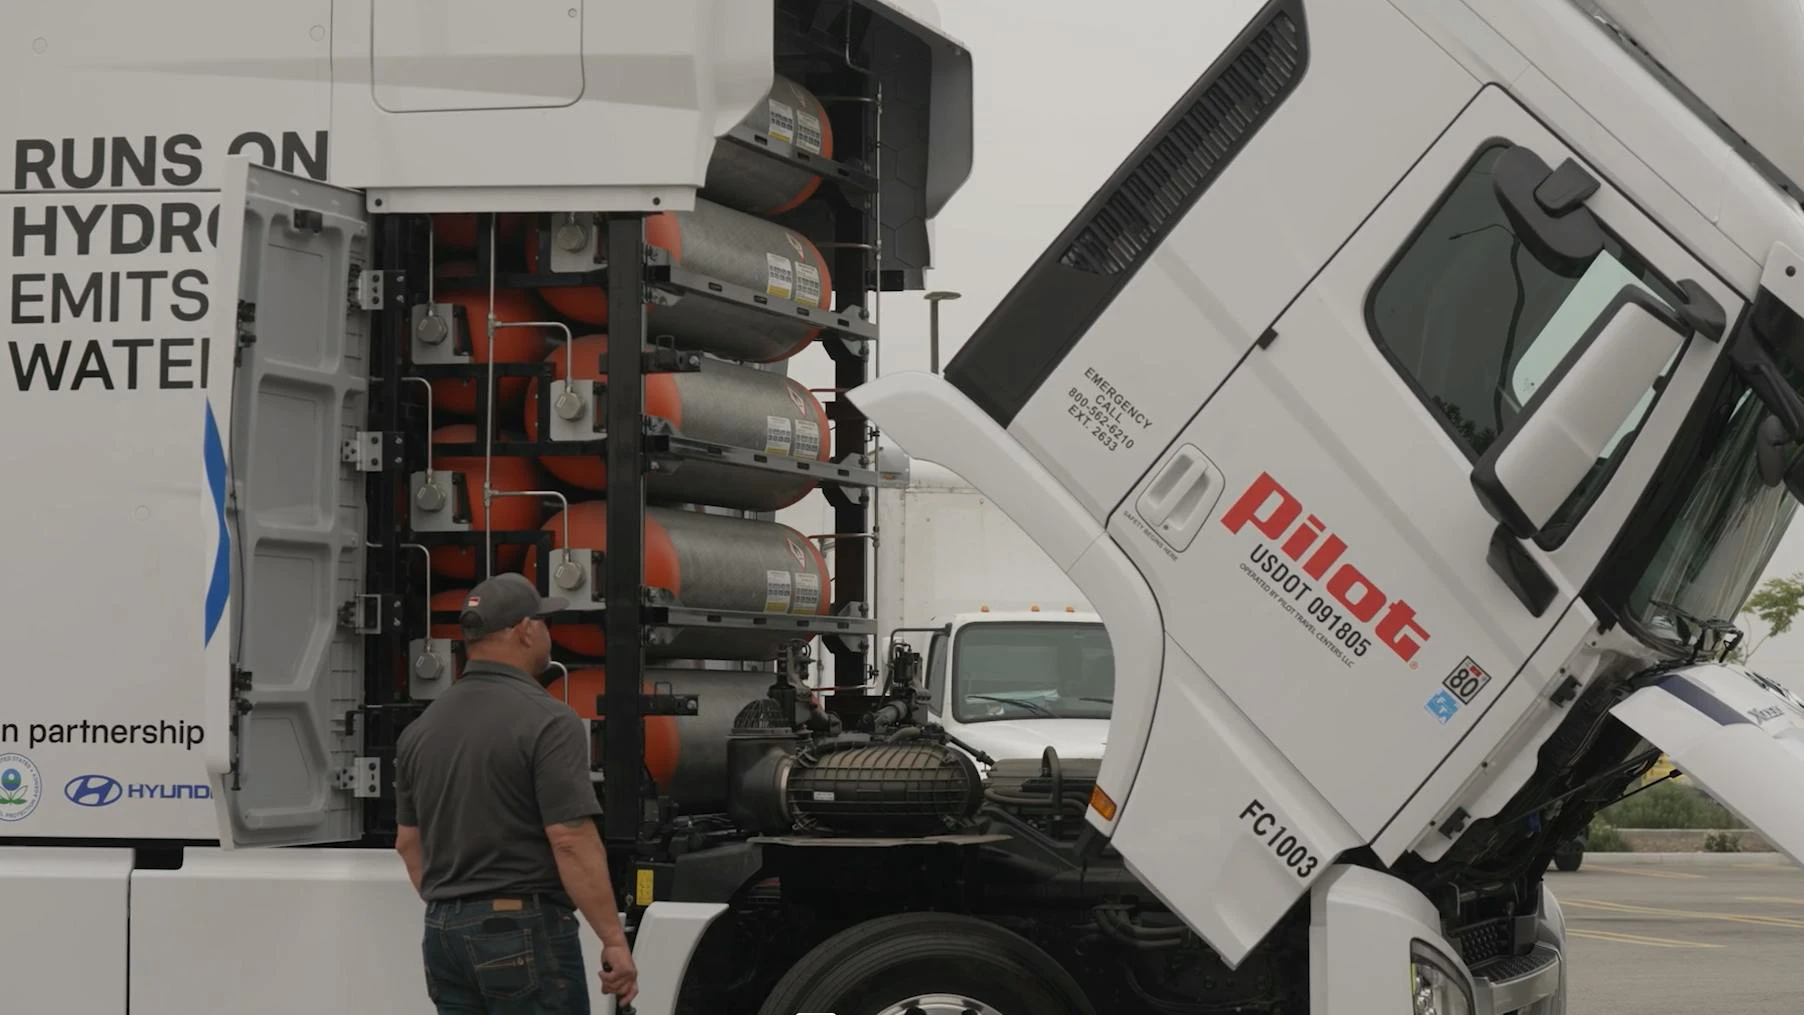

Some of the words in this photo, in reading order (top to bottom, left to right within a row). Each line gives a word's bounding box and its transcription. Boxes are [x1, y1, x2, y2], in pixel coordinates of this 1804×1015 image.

[14, 134, 203, 190] RUNS
[227, 130, 328, 182] ON
[12, 203, 221, 256] HYDR
[10, 269, 209, 324] EMITS
[8, 338, 210, 391] WATE
[1068, 387, 1134, 449] 800-562-6210
[1084, 367, 1152, 429] EMERGENCY
[1095, 394, 1122, 424] CALL
[1068, 404, 1091, 429] EXT.
[1092, 426, 1118, 451] 2633
[1240, 563, 1271, 593] OPERATED
[1269, 590, 1280, 601] BY
[1278, 597, 1296, 616] PILOT
[1294, 612, 1317, 635] TRAVEL
[1315, 632, 1342, 658] CENTERS
[1341, 655, 1355, 668] LLC
[1250, 543, 1312, 601] USDOT
[1307, 597, 1372, 656] 091805
[1450, 668, 1478, 697] 80
[29, 720, 205, 750] partnership
[128, 784, 213, 799] HYUND
[1239, 799, 1318, 878] FC1003
